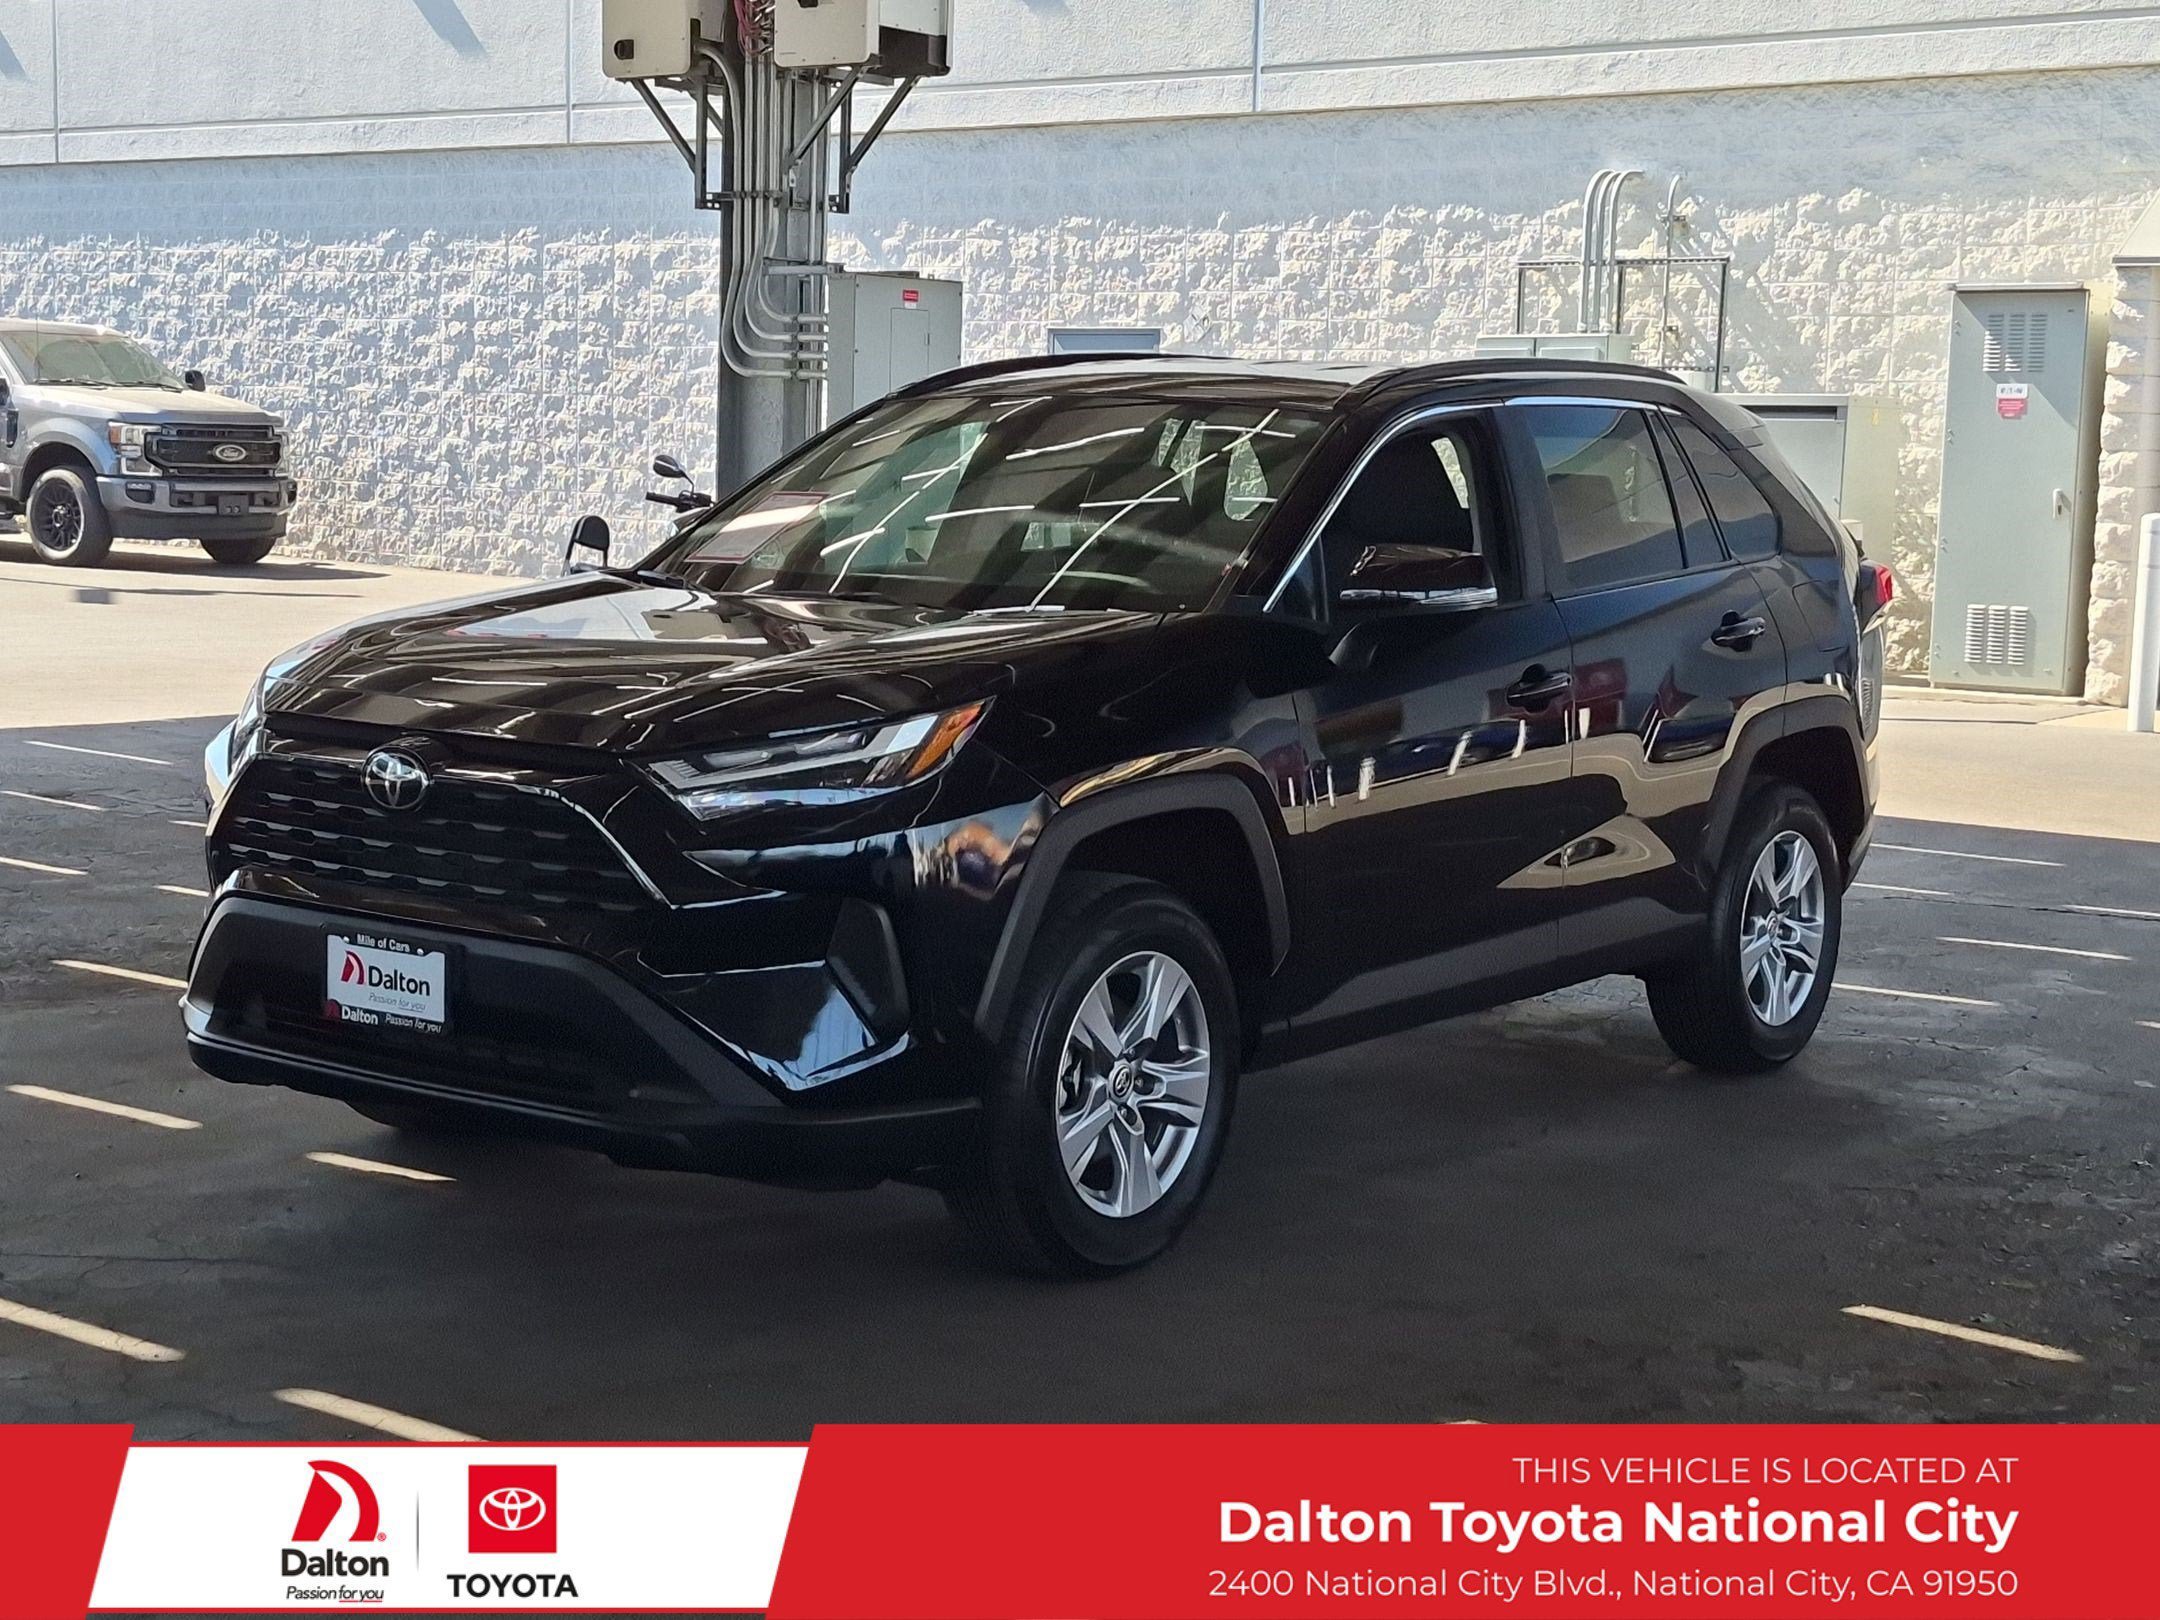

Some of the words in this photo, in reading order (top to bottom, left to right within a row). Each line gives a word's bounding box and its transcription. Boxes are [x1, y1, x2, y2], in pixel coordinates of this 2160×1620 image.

[356, 933, 375, 947] Mile
[377, 938, 387, 948] of
[389, 939, 411, 952] Cars
[368, 965, 430, 996] Dalton
[341, 1006, 379, 1025] Dalton
[411, 1001, 426, 1012] you
[385, 1013, 413, 1028] Passion
[414, 1018, 426, 1029] for
[426, 1023, 442, 1034] you
